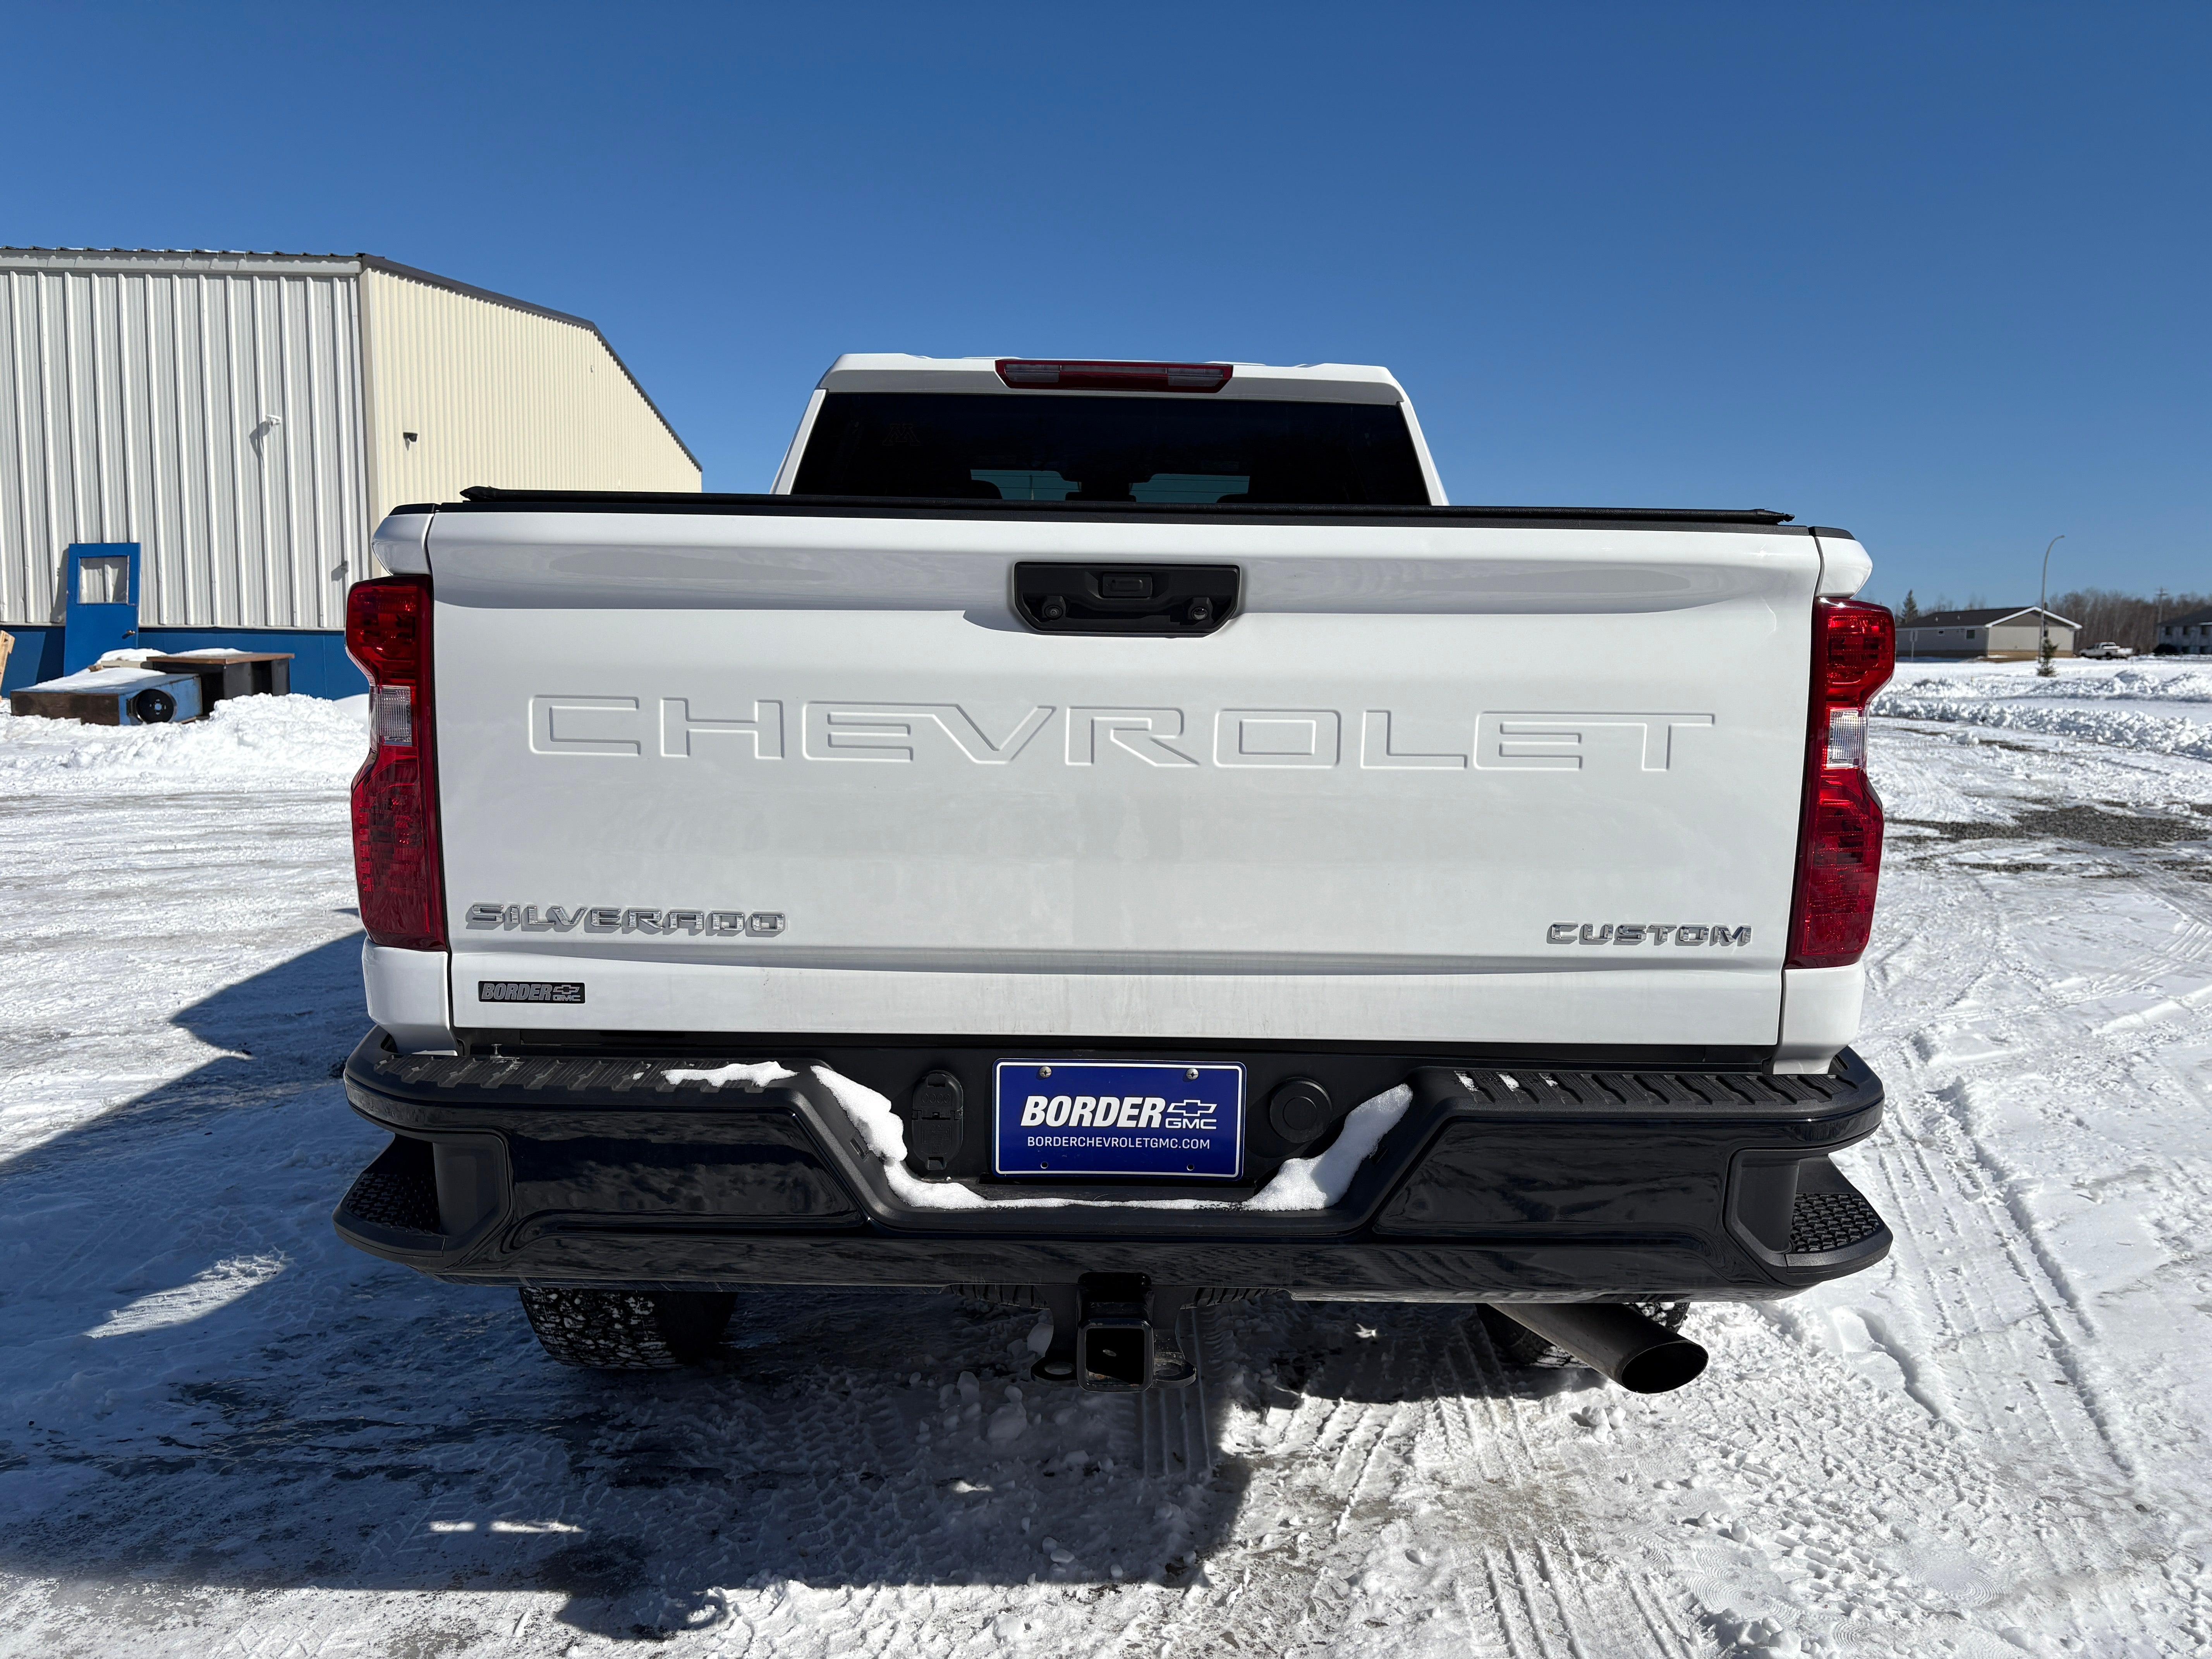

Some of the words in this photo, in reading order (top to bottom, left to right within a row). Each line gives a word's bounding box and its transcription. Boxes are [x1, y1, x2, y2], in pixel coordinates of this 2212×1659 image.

[528, 694, 1715, 773] CHEVROLET
[471, 903, 788, 933] SILVERADO
[1550, 922, 1753, 944] CUSTOM
[481, 983, 553, 1001] BORDER
[1020, 1095, 1166, 1128] BORDER
[1165, 1118, 1217, 1130] GMC
[1027, 1136, 1211, 1150] BORDERCHEVROLETGMC.COM
